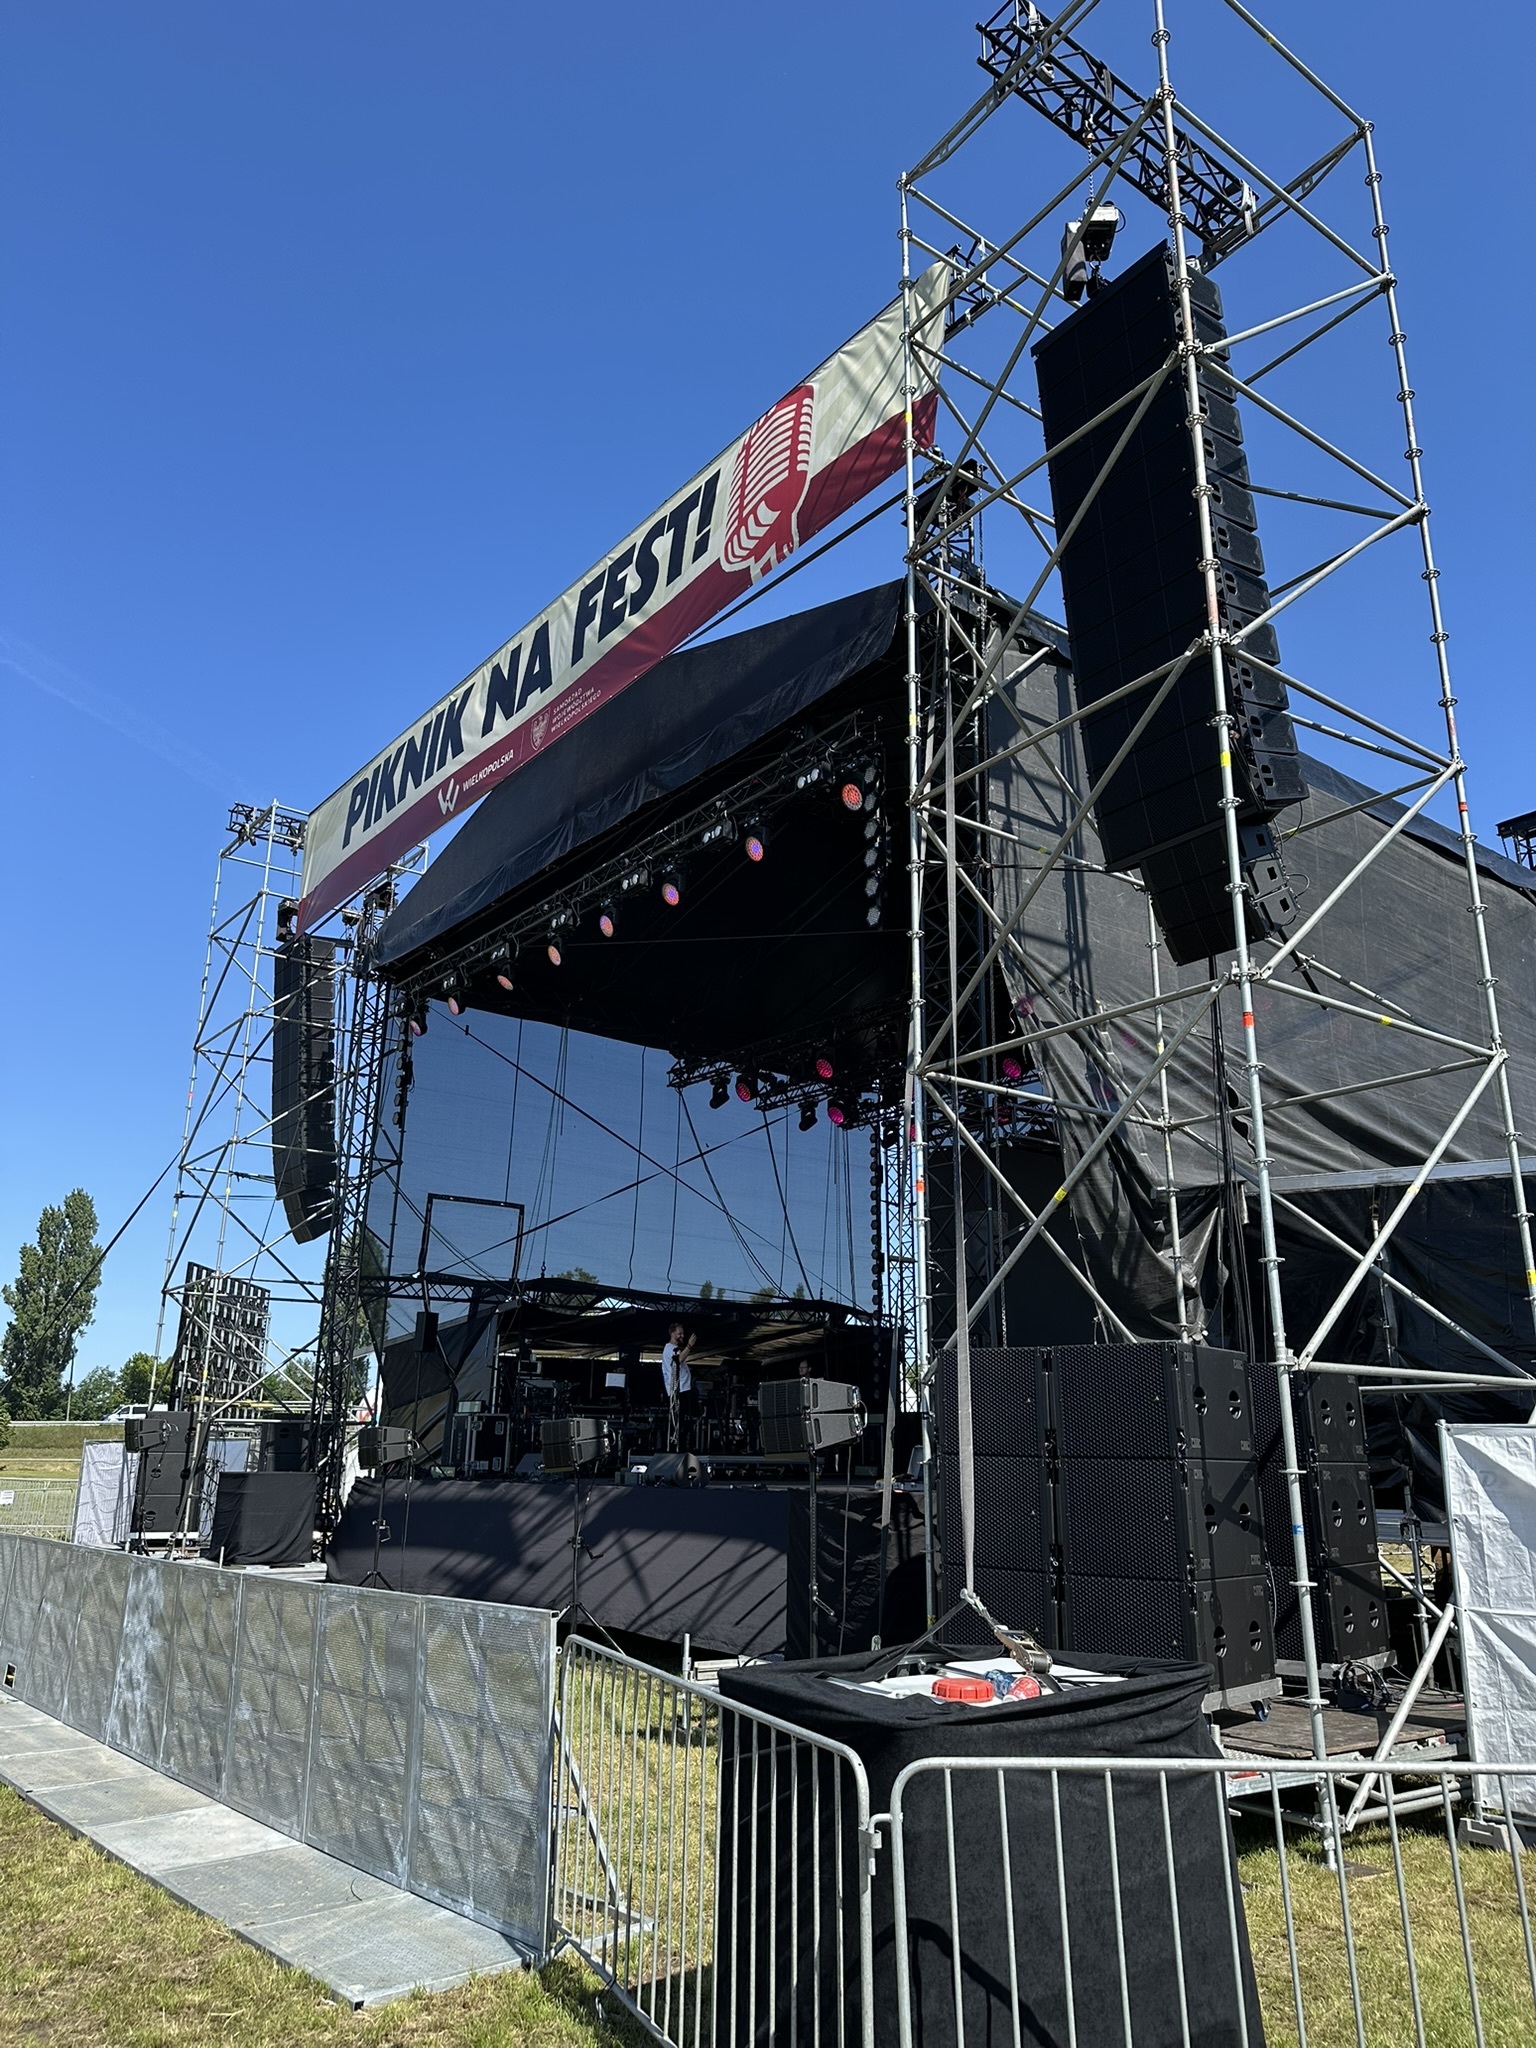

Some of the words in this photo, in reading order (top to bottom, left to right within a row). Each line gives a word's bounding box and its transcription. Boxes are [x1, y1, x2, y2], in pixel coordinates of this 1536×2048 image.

[341, 682, 475, 850] PIKNIK
[481, 619, 553, 738] NA
[571, 468, 720, 668] FEST!
[462, 748, 515, 792] WIELKOPOLSKA
